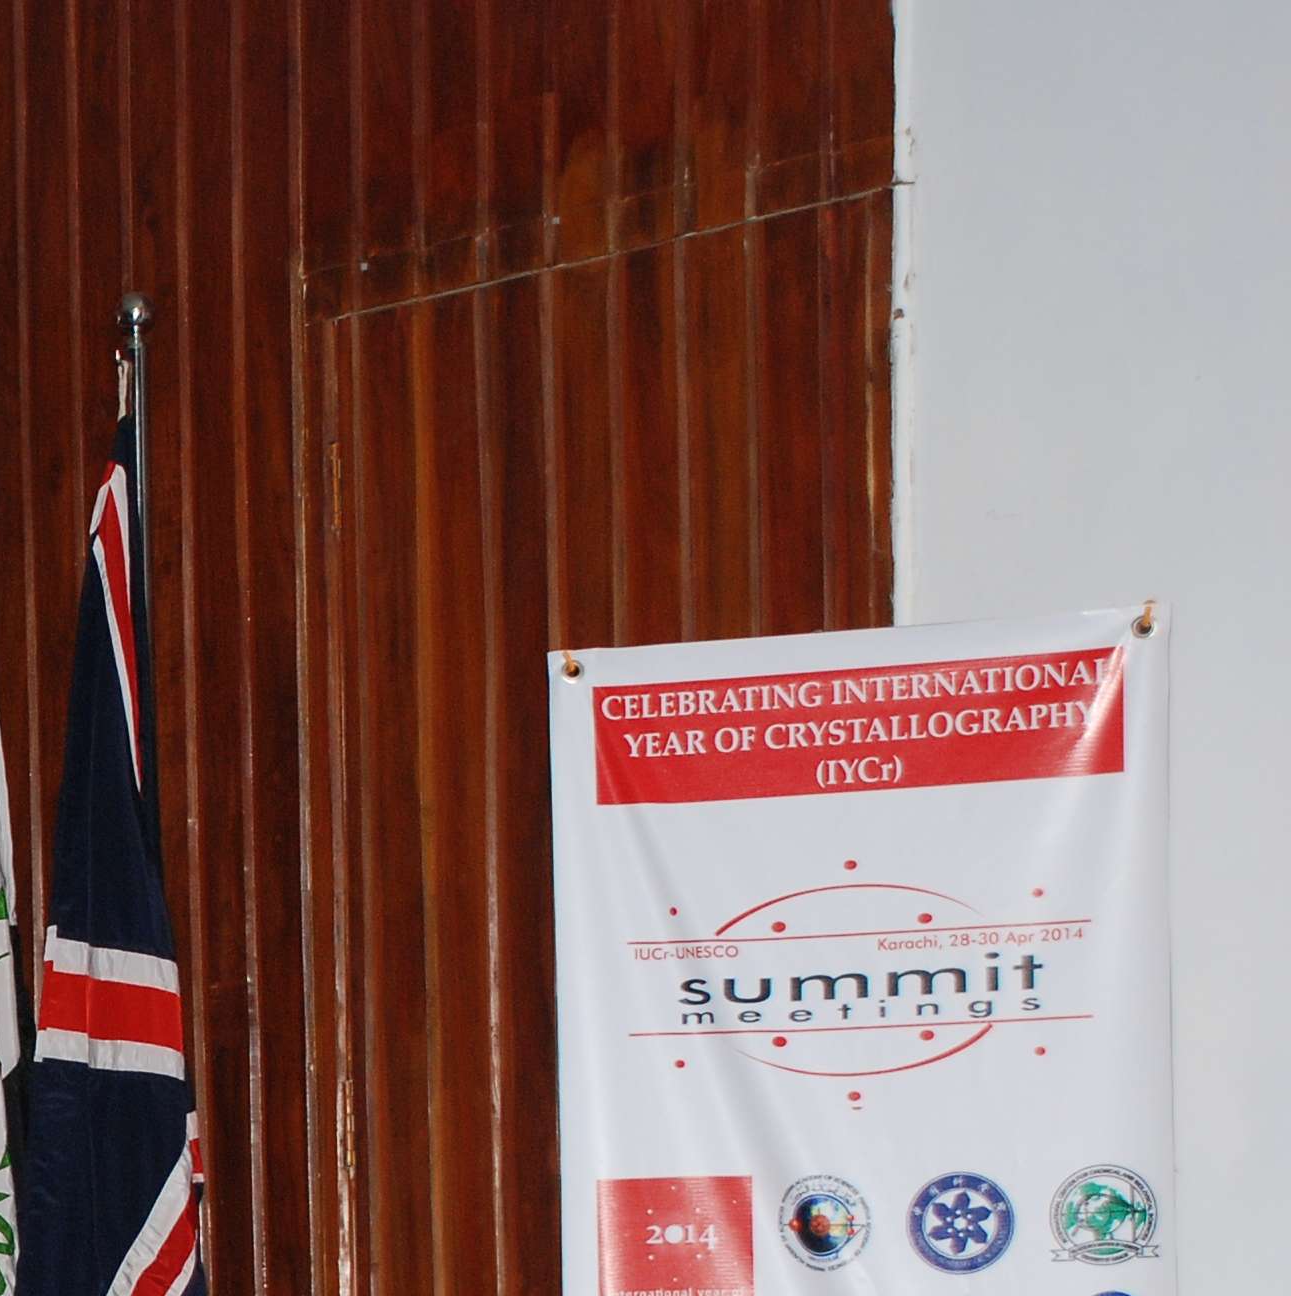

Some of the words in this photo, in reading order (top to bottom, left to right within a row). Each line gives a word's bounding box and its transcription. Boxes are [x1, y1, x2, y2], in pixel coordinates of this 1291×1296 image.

[601, 681, 822, 720] CELEBRATING
[832, 658, 1109, 705] INTERNATIONAL
[624, 730, 706, 758] YEAR
[714, 726, 756, 753] OF
[764, 701, 1092, 750] CRYSTALLOGRAPHY
[816, 755, 904, 788] (IYCr)
[635, 945, 739, 960] IUCr-UNESCO
[877, 935, 943, 951] Karachi,
[949, 932, 999, 947] 28-30
[1005, 932, 1034, 947] Apr
[1041, 928, 1083, 942] 2014
[678, 952, 1043, 1006] summit
[681, 997, 1041, 1024] meetings
[645, 1224, 716, 1250] 2014
